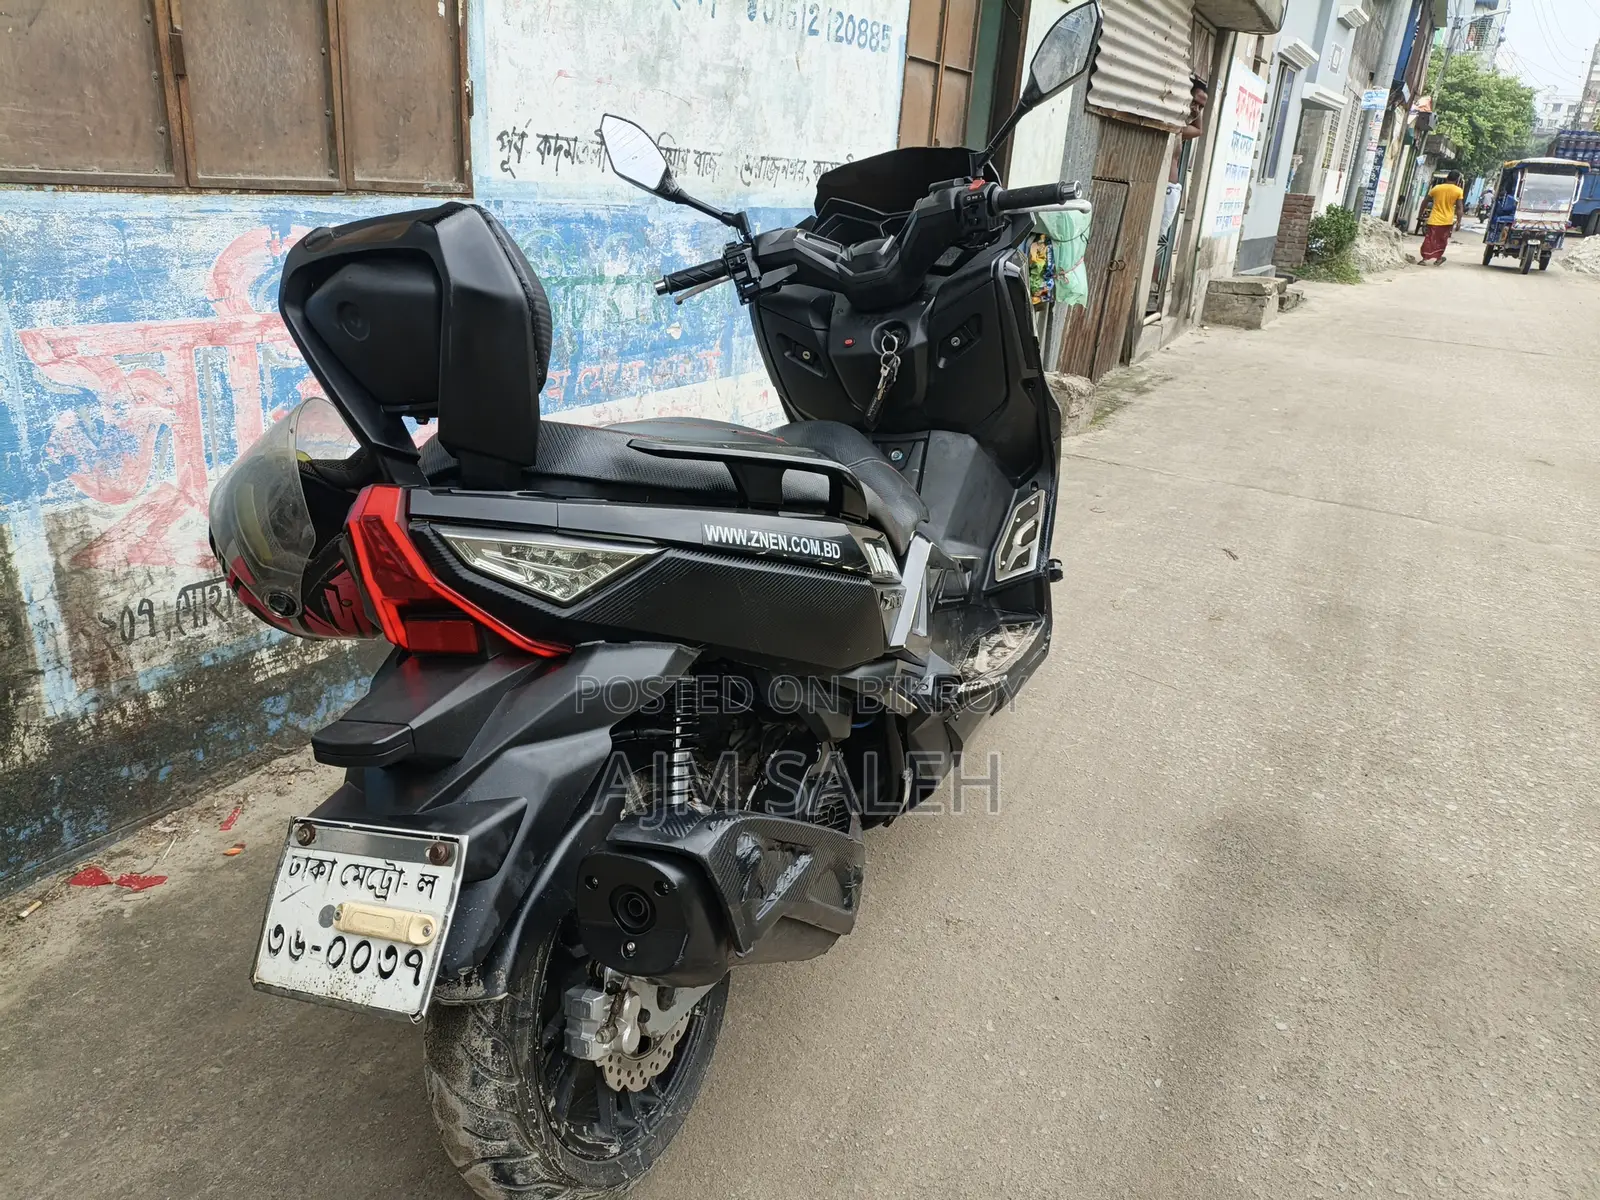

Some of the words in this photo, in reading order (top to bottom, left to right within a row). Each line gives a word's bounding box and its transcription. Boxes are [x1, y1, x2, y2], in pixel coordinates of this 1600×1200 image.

[704, 524, 841, 560] WWW.ZNEN.COM.BD
[288, 855, 338, 882] ঢাকা
[267, 923, 425, 987] ৩৬-০০৩৭
